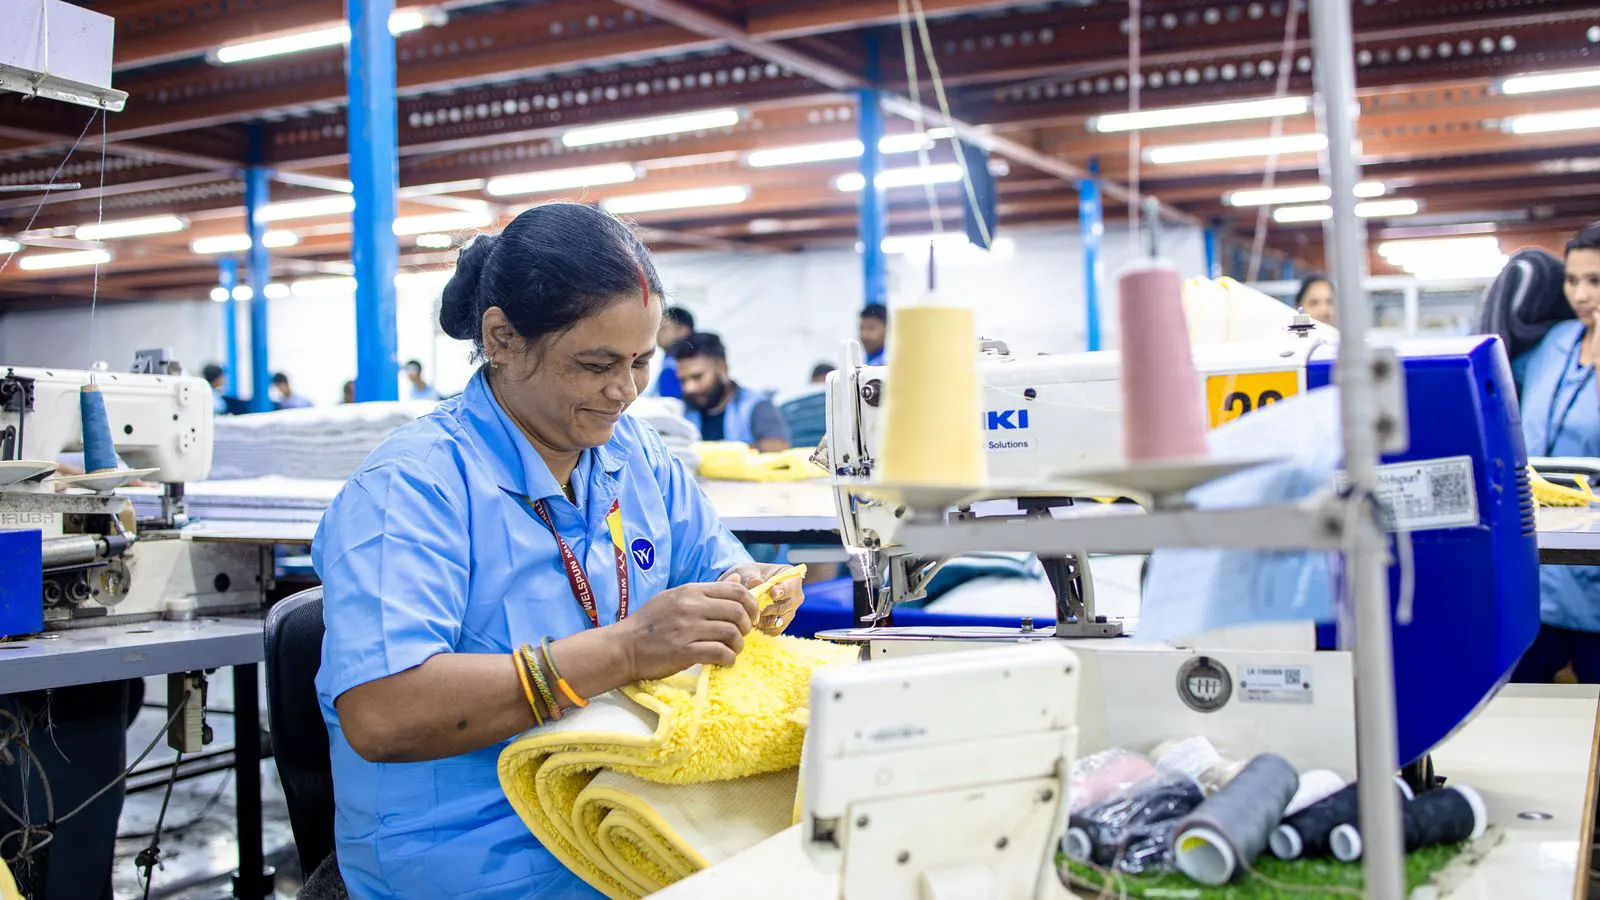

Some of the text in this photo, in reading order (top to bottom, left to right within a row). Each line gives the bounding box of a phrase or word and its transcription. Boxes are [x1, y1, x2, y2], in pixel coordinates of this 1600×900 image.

[982, 410, 1028, 429] KI
[989, 441, 1028, 449] Solutions
[570, 562, 592, 610] WELSPUN
